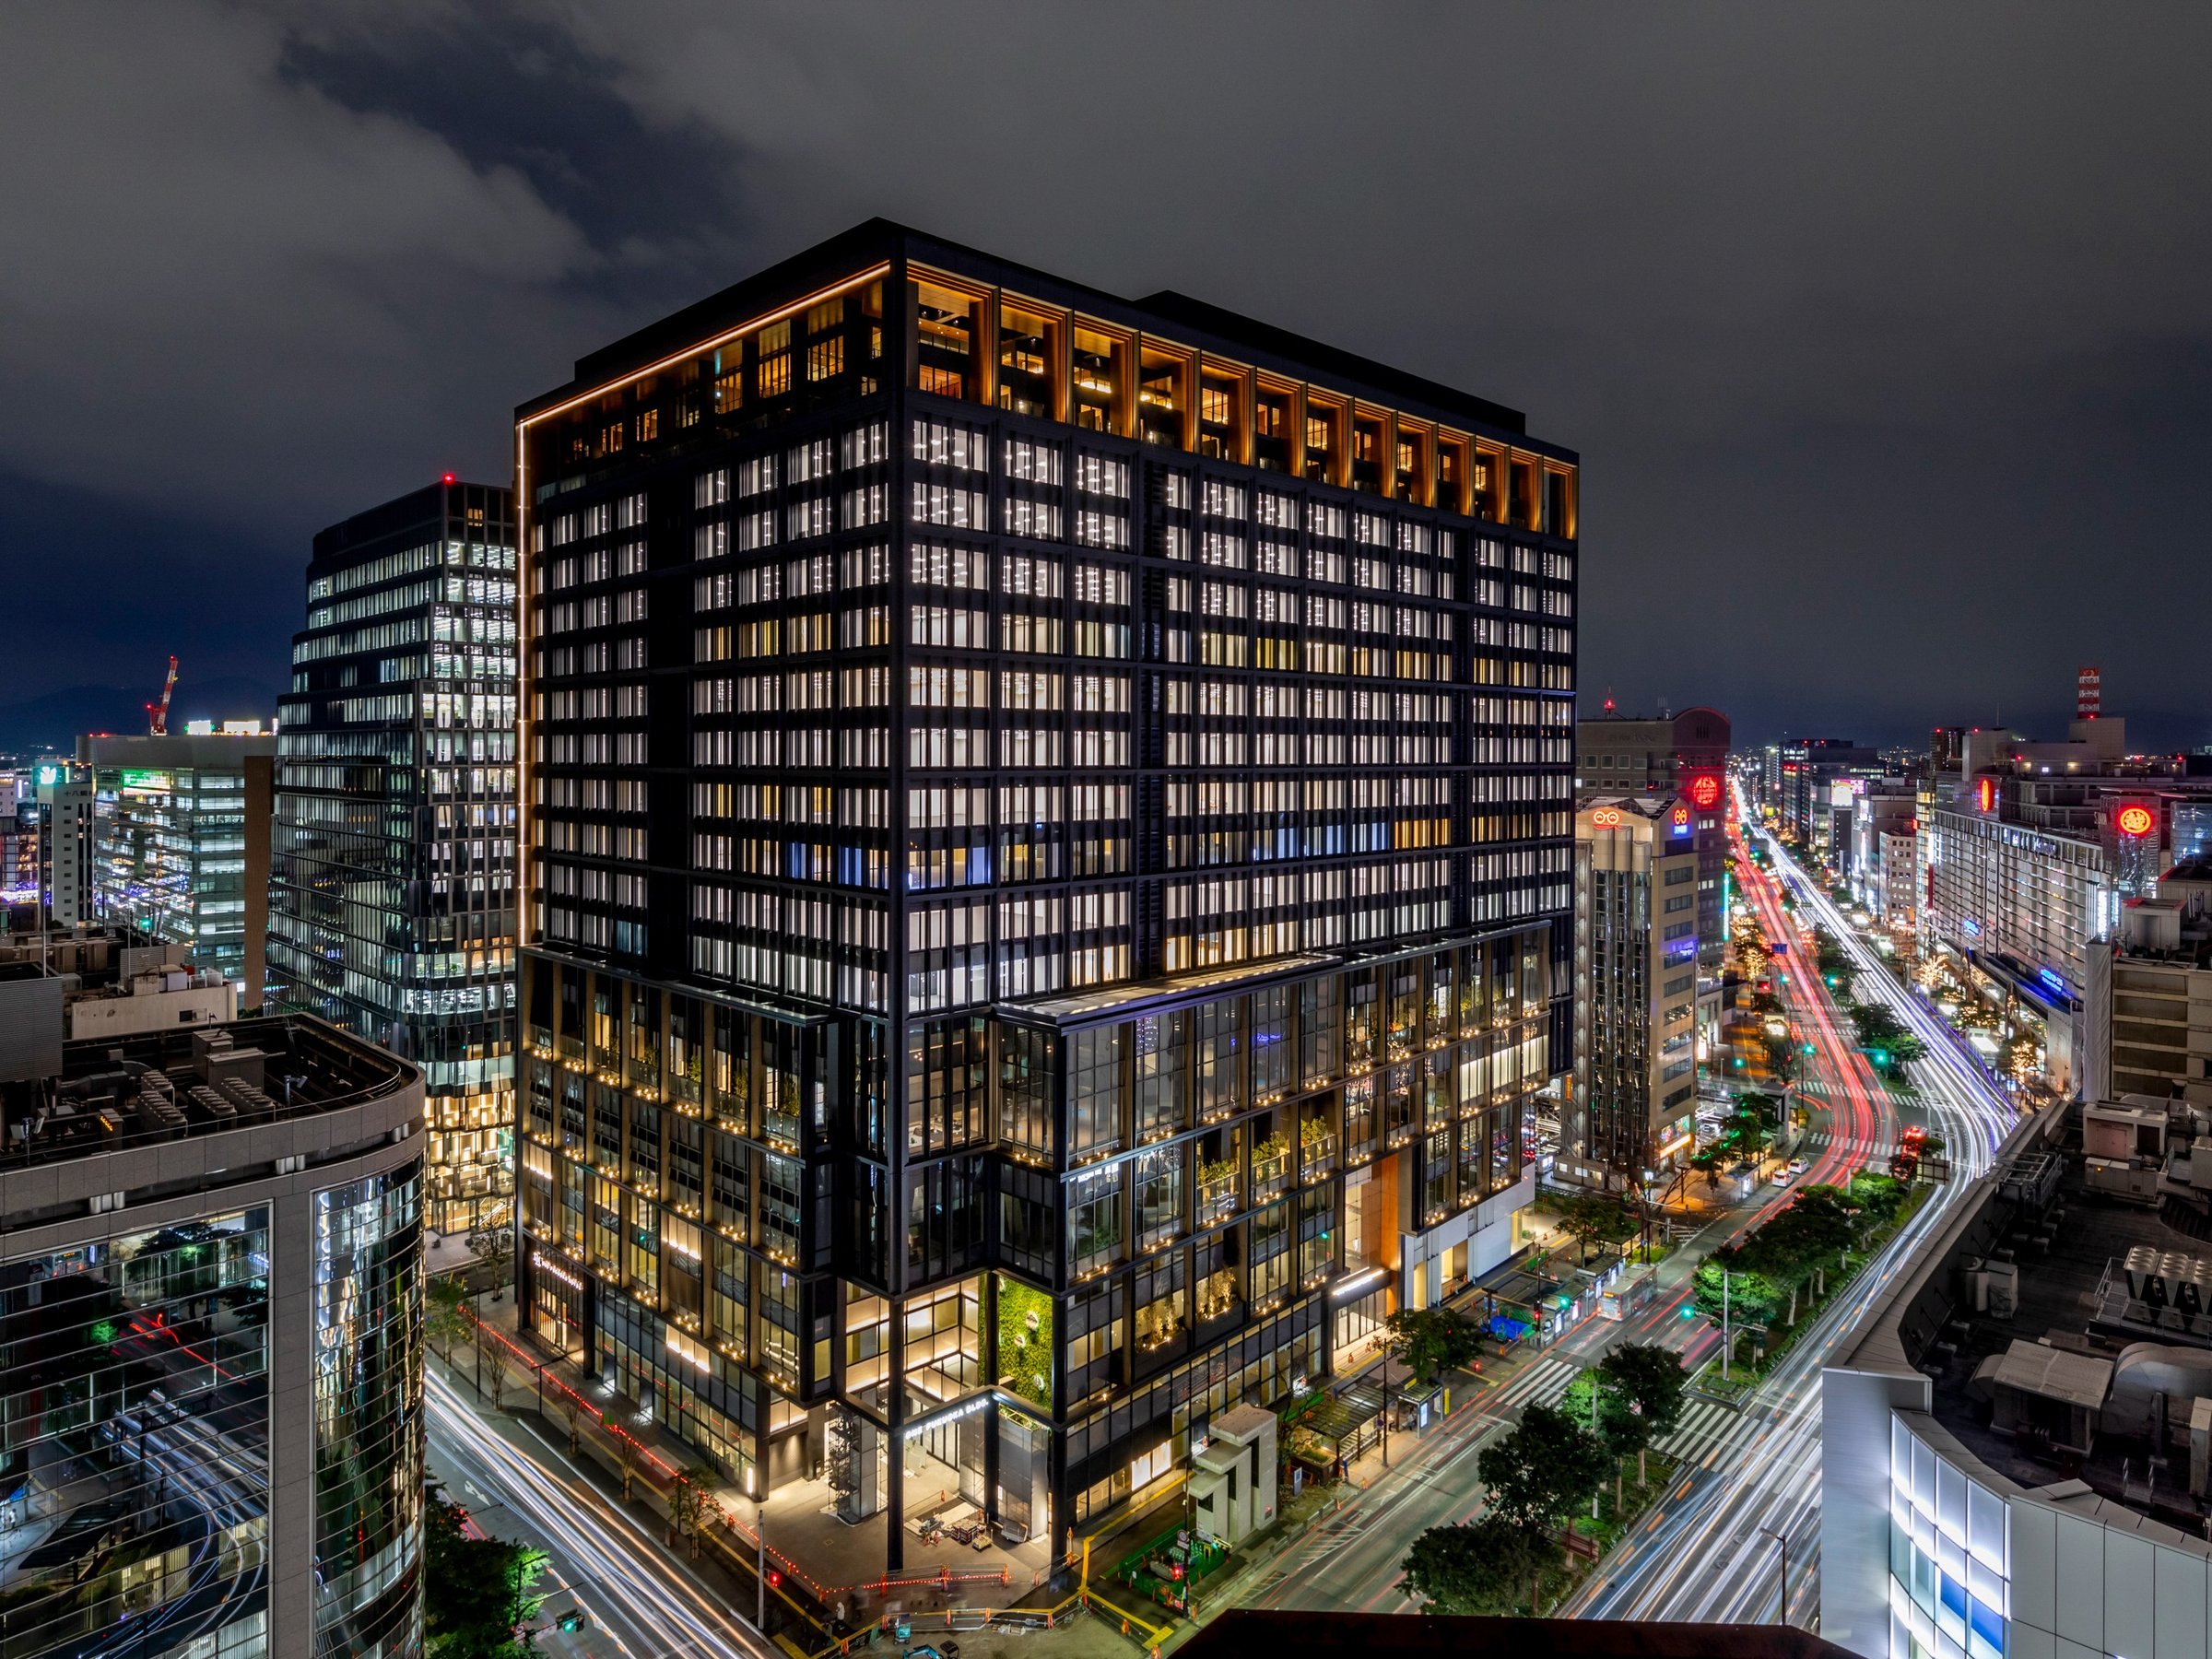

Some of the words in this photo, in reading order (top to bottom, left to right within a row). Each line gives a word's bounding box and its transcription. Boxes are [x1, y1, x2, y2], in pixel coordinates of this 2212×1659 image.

[905, 1426, 924, 1440] ONE
[925, 1408, 964, 1430] FUKUOKA
[965, 1398, 989, 1415] BLDG.
